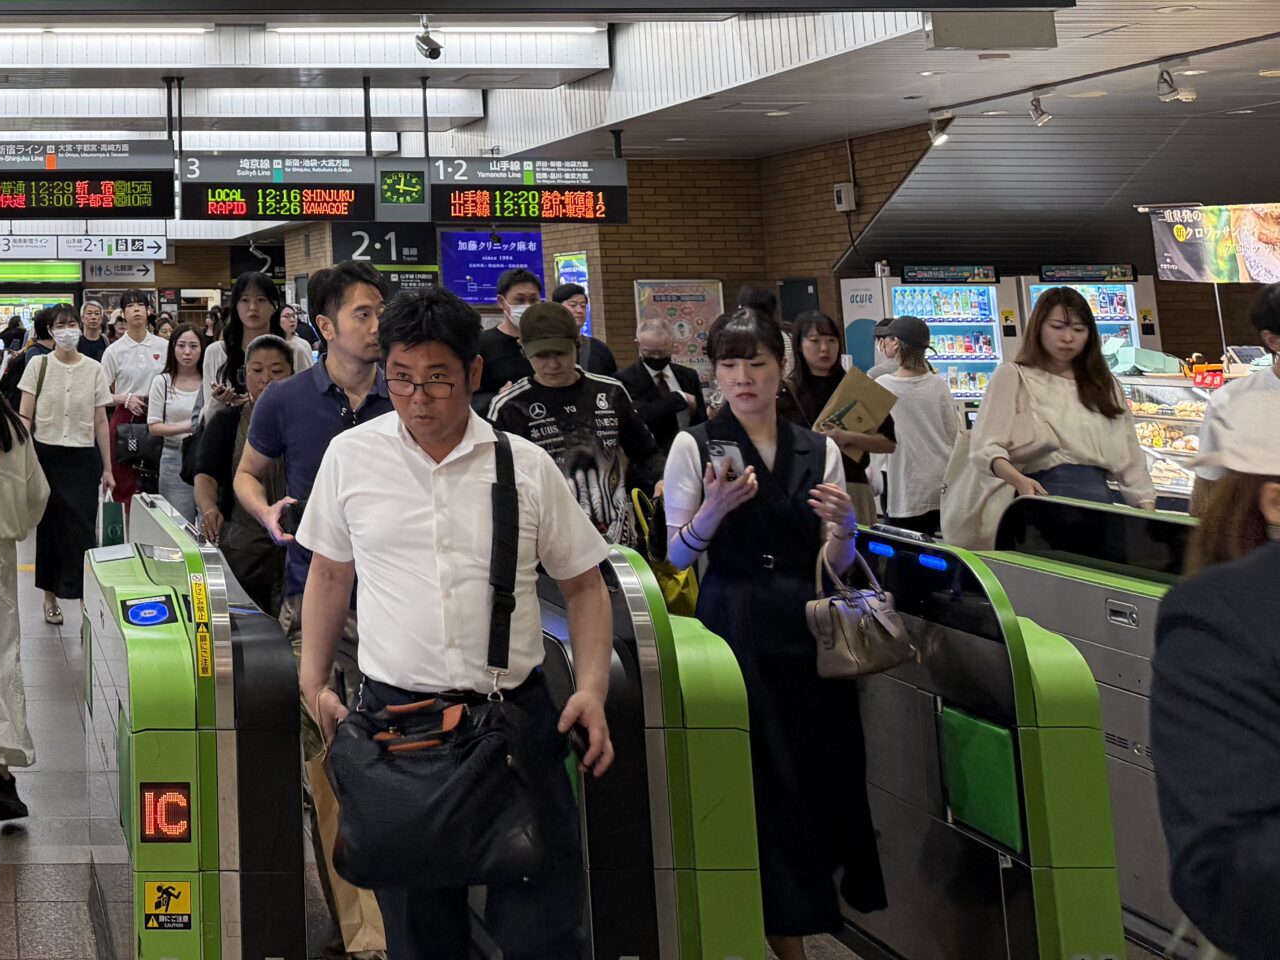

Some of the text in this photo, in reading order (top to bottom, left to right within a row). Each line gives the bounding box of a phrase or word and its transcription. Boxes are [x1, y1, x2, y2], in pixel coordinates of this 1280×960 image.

[186, 157, 200, 179] 3
[239, 159, 270, 169] 埼京線
[489, 161, 520, 171] 山手線
[30, 181, 73, 194] 12:29
[30, 194, 73, 207] 13:00
[208, 189, 355, 202] LOCAL 12:16 SHINJUKU
[451, 190, 490, 204] 山手線
[495, 190, 539, 204] 12:20
[208, 202, 348, 214] RAPID 12:26 KAWAGOE
[451, 203, 490, 217] 山手線
[495, 203, 539, 217] 12:18
[457, 239, 537, 251] 加藤クリニック麻布
[849, 293, 873, 304] acure
[540, 425, 559, 436] UBS
[145, 792, 187, 835] IC
